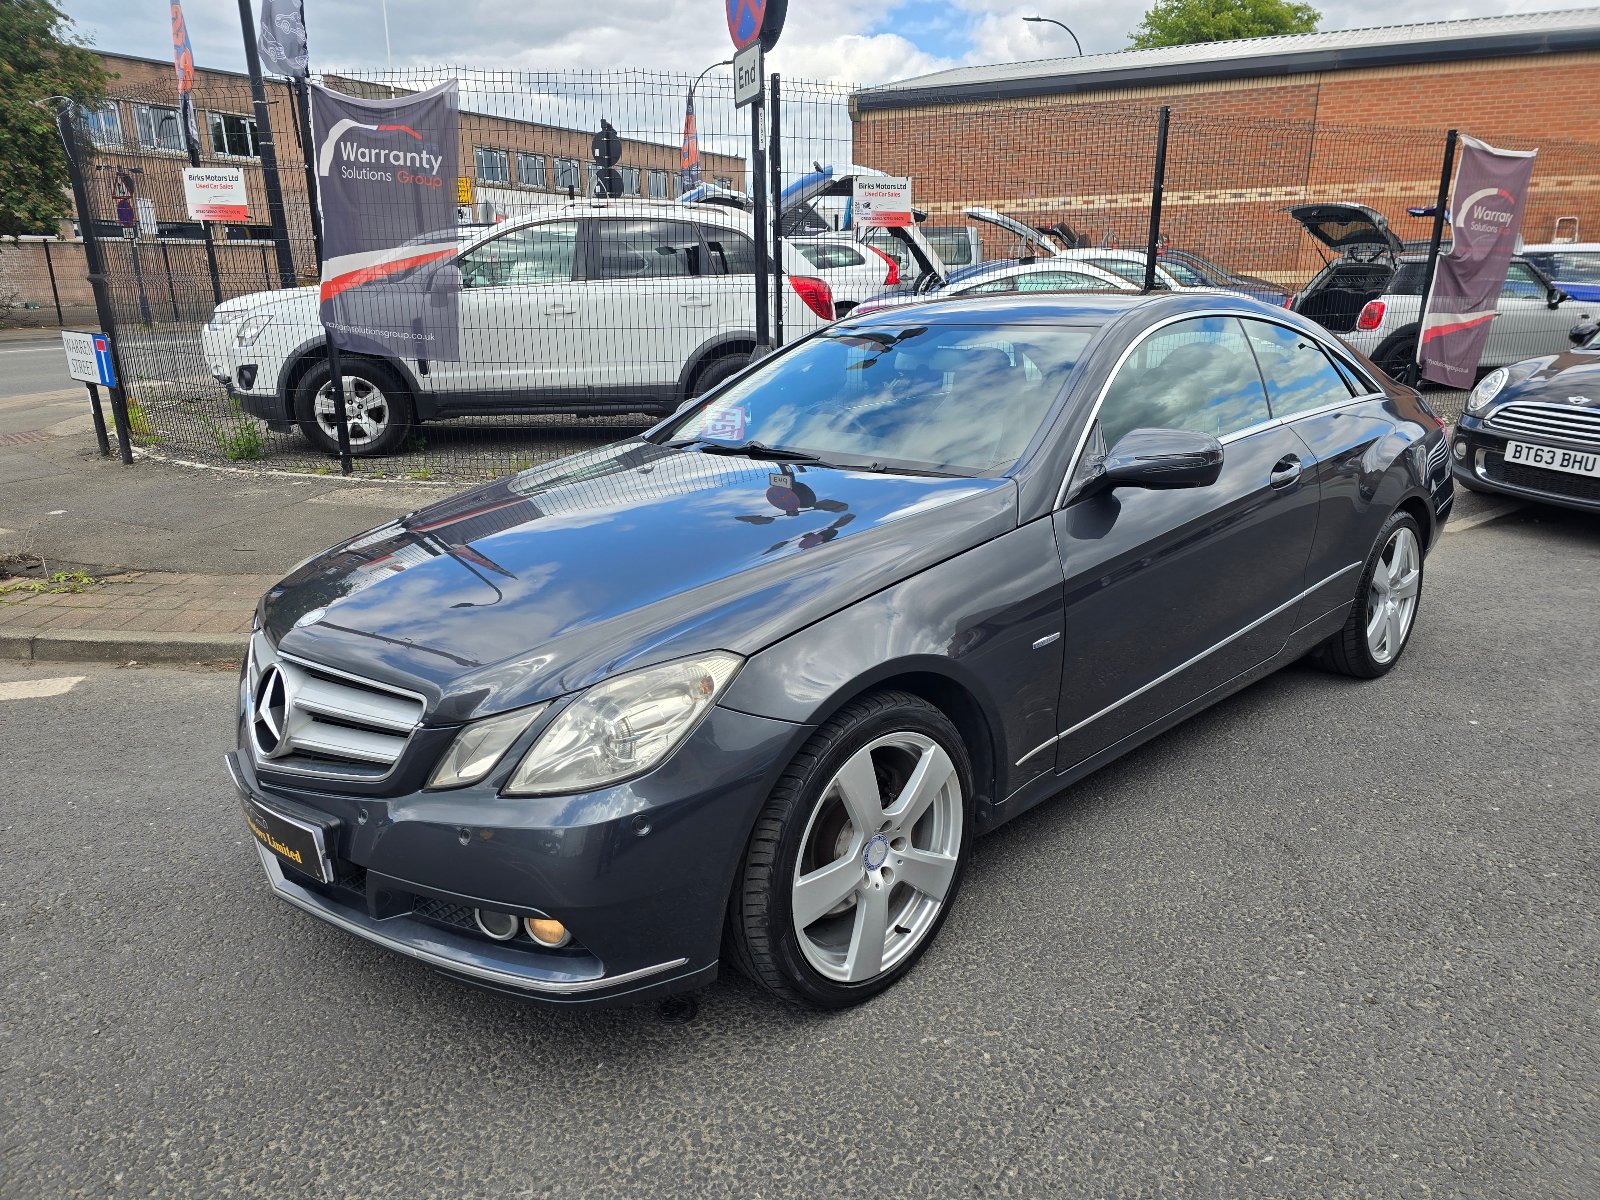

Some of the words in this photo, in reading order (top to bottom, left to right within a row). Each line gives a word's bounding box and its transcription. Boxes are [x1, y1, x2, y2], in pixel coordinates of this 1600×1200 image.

[738, 59, 756, 89] End
[340, 141, 442, 176] Warranty
[341, 165, 392, 182] Solutions
[397, 170, 443, 189] Group
[876, 182, 896, 190] Motors
[64, 338, 93, 355] WARREN
[71, 358, 95, 376] STREET
[1512, 444, 1556, 465] BT63
[1559, 452, 1597, 472] BHU
[266, 832, 302, 864] Limited
